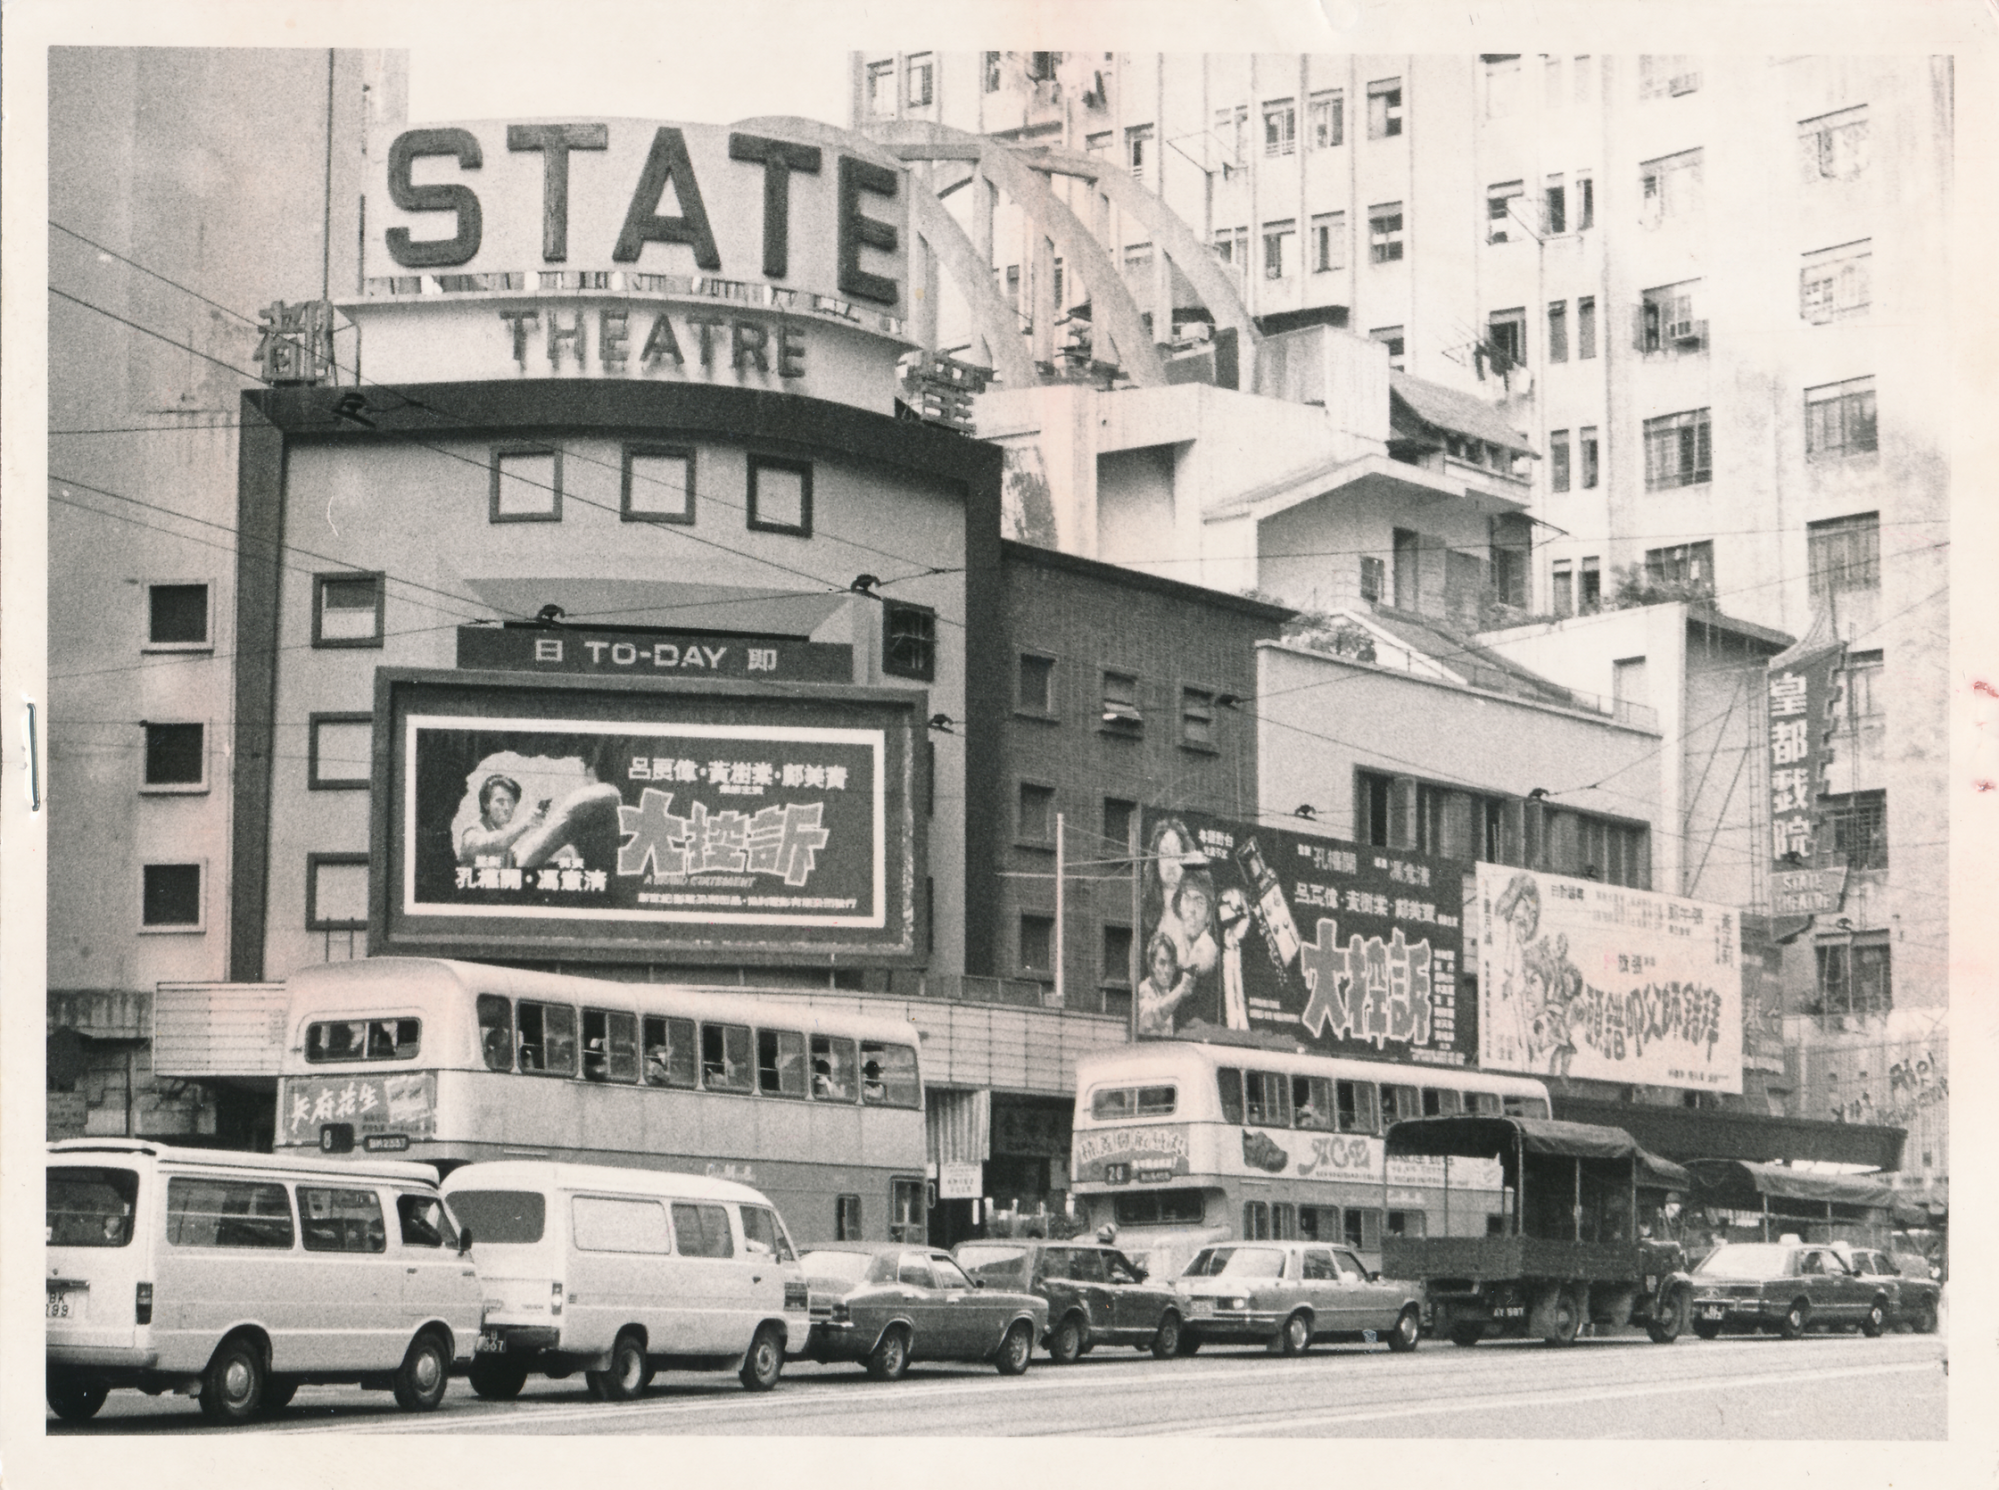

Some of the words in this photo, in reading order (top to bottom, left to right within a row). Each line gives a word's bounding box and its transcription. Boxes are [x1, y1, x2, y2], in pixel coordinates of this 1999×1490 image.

[385, 123, 899, 303] STATE
[501, 308, 805, 378] THEATRE
[536, 639, 563, 662] 日
[585, 640, 727, 669] TO-DAY
[617, 788, 830, 886] 大控訴
[1301, 918, 1431, 1050] 大控訴
[323, 1129, 332, 1149] 8
[49, 1292, 66, 1304] BK
